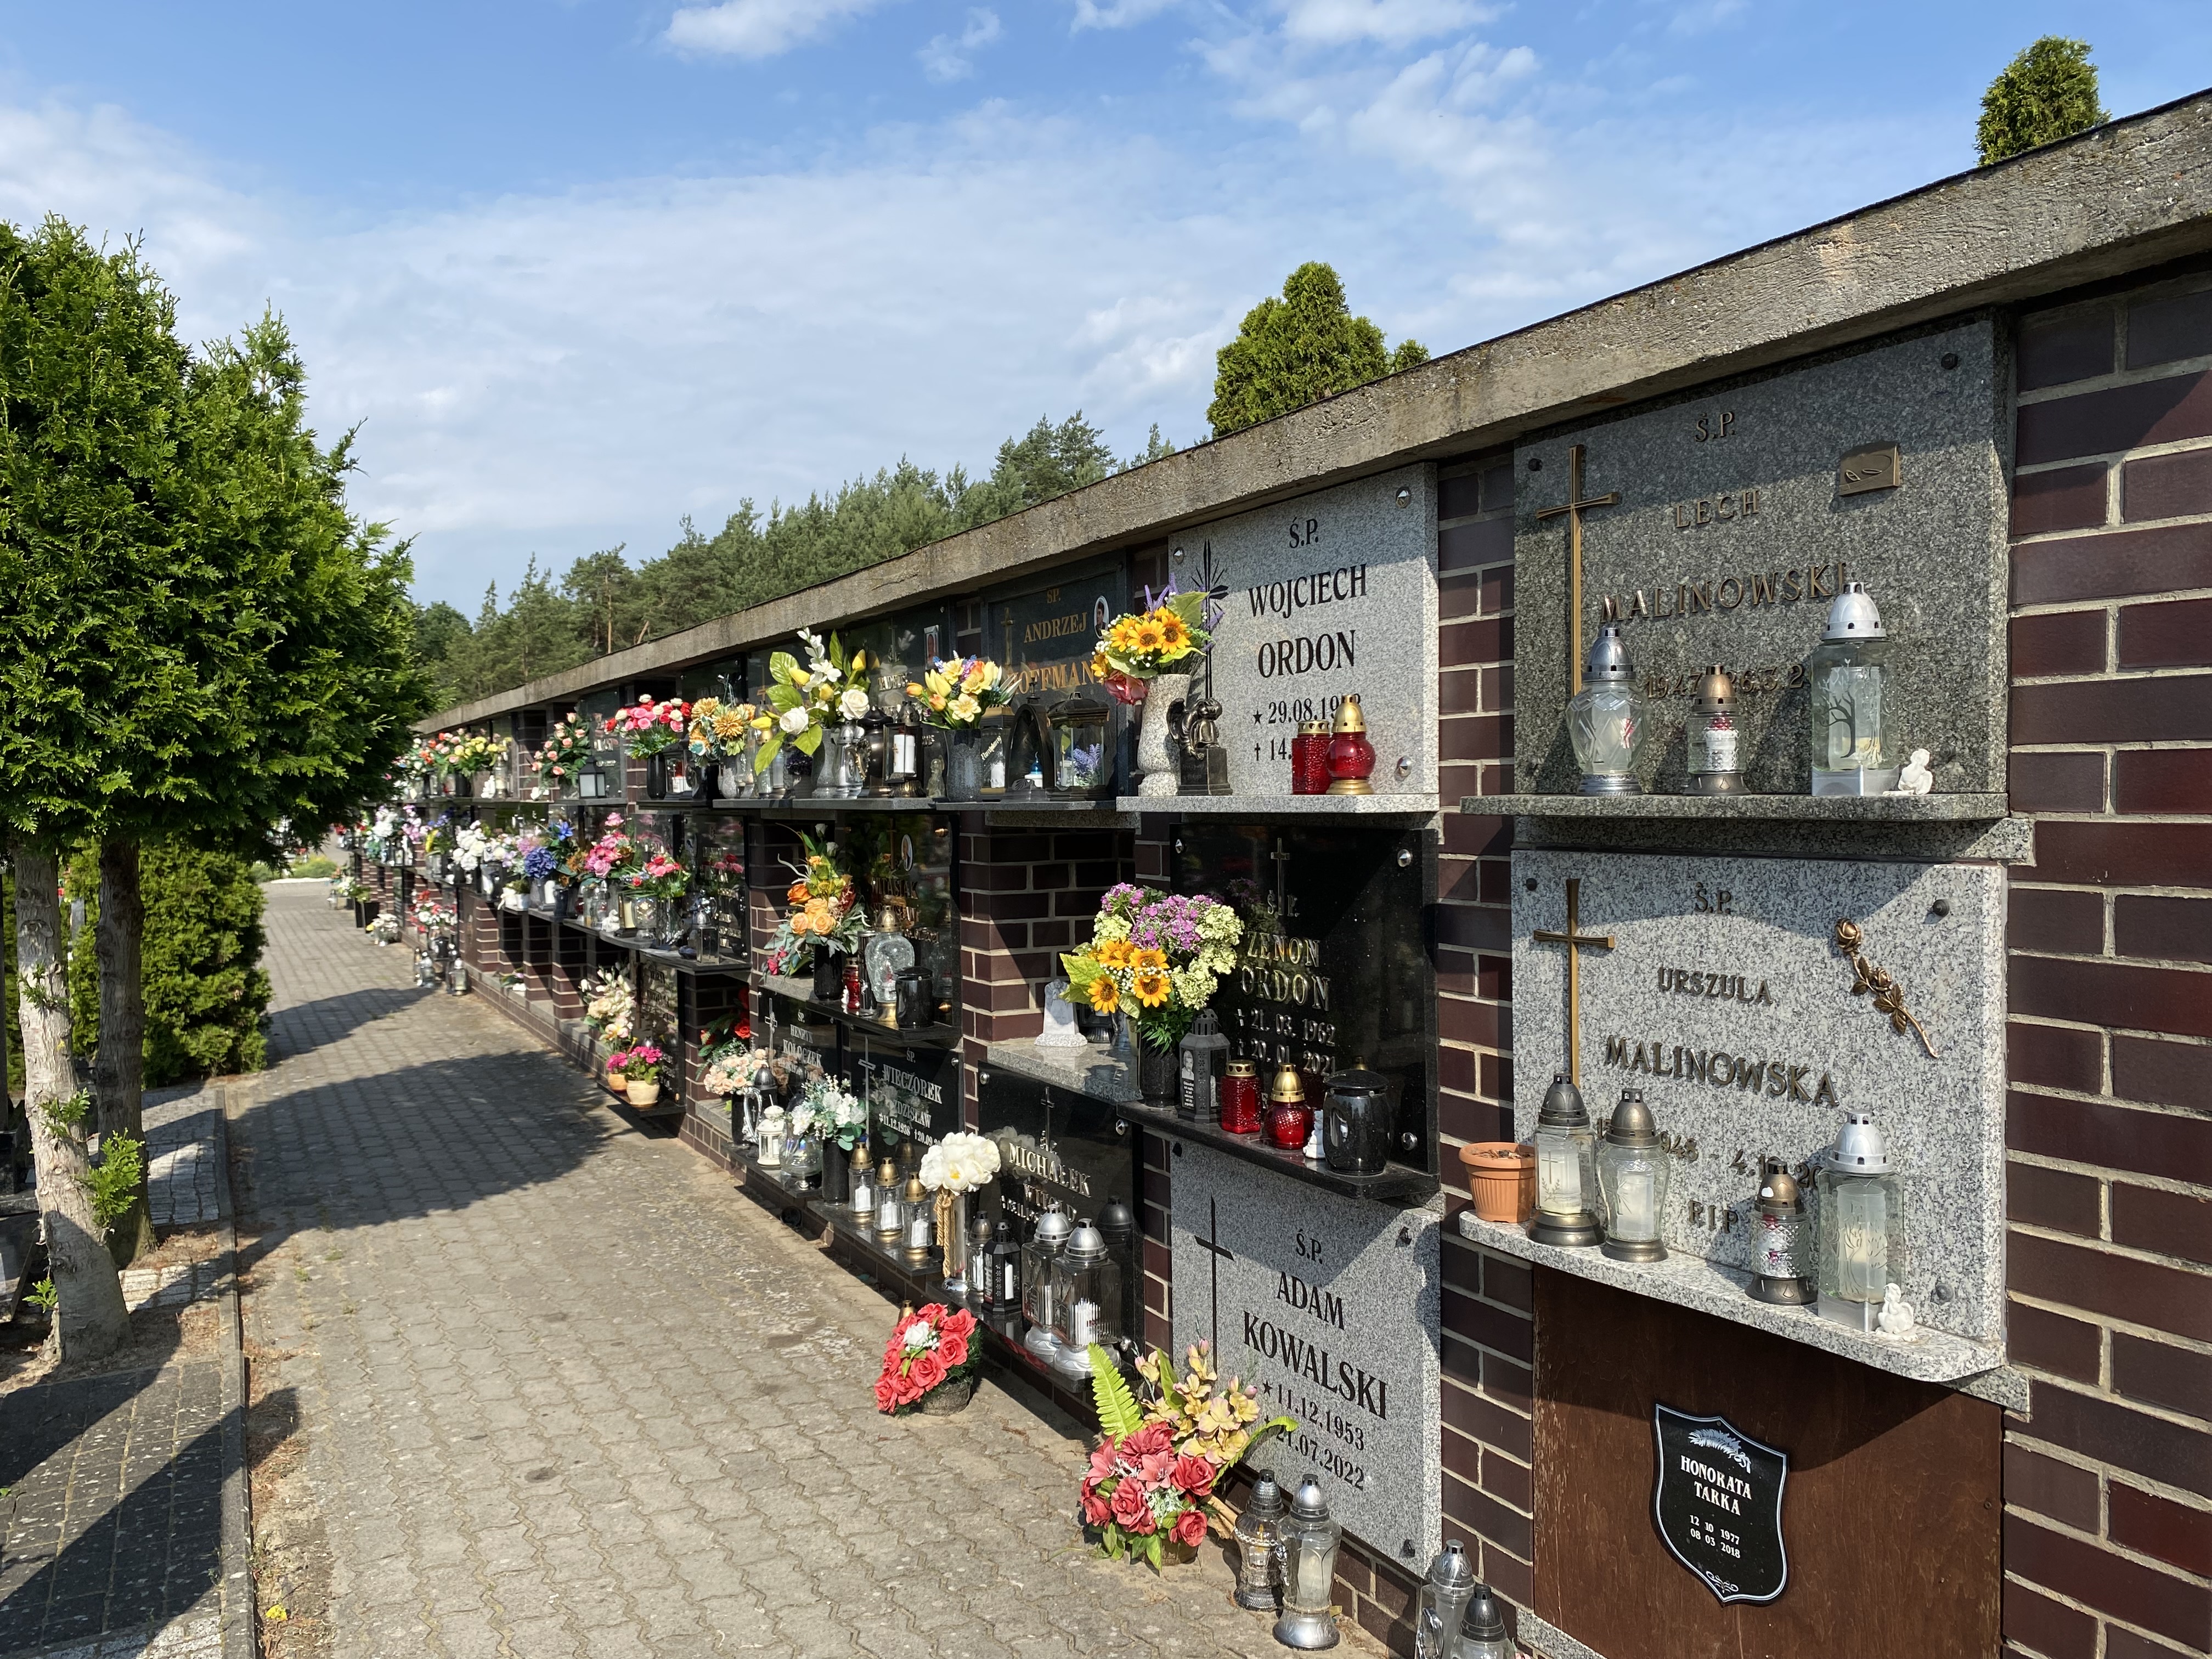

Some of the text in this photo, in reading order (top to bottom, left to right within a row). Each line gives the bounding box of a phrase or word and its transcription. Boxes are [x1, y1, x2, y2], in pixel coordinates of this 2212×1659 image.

[1675, 489, 1760, 528] LECH
[1289, 517, 1319, 549] Ś.P.
[1248, 563, 1367, 619] WOJCIECH
[1600, 561, 1847, 623] MALINOWSKI
[1024, 612, 1087, 644] ANDRZEJ
[1258, 630, 1356, 678] ORDON
[1007, 660, 1104, 696] OFFMAN
[1268, 693, 1361, 724] 29.08.19
[1246, 931, 1321, 968] ZENON
[1240, 966, 1331, 1012] ORDON
[1657, 966, 1773, 1006] URSZULA
[790, 1024, 814, 1043] HENRYK
[1302, 1018, 1336, 1047] 1962
[1302, 1050, 1336, 1076] 2021
[1605, 1035, 1839, 1106] MALINOWSKA
[1009, 1142, 1092, 1198] MICHAŁEK
[1295, 1228, 1323, 1264] Ś.P.
[1276, 1271, 1345, 1330] ADAM
[1243, 1311, 1388, 1420] KOWALSKI
[1278, 1384, 1364, 1451] 11.12.1953
[1680, 1455, 1752, 1500] HONORATA
[1694, 1480, 1741, 1516] TARKA
[1689, 1514, 1740, 1545] 12 10 1977
[1690, 1528, 1741, 1559] 08 03 2018
